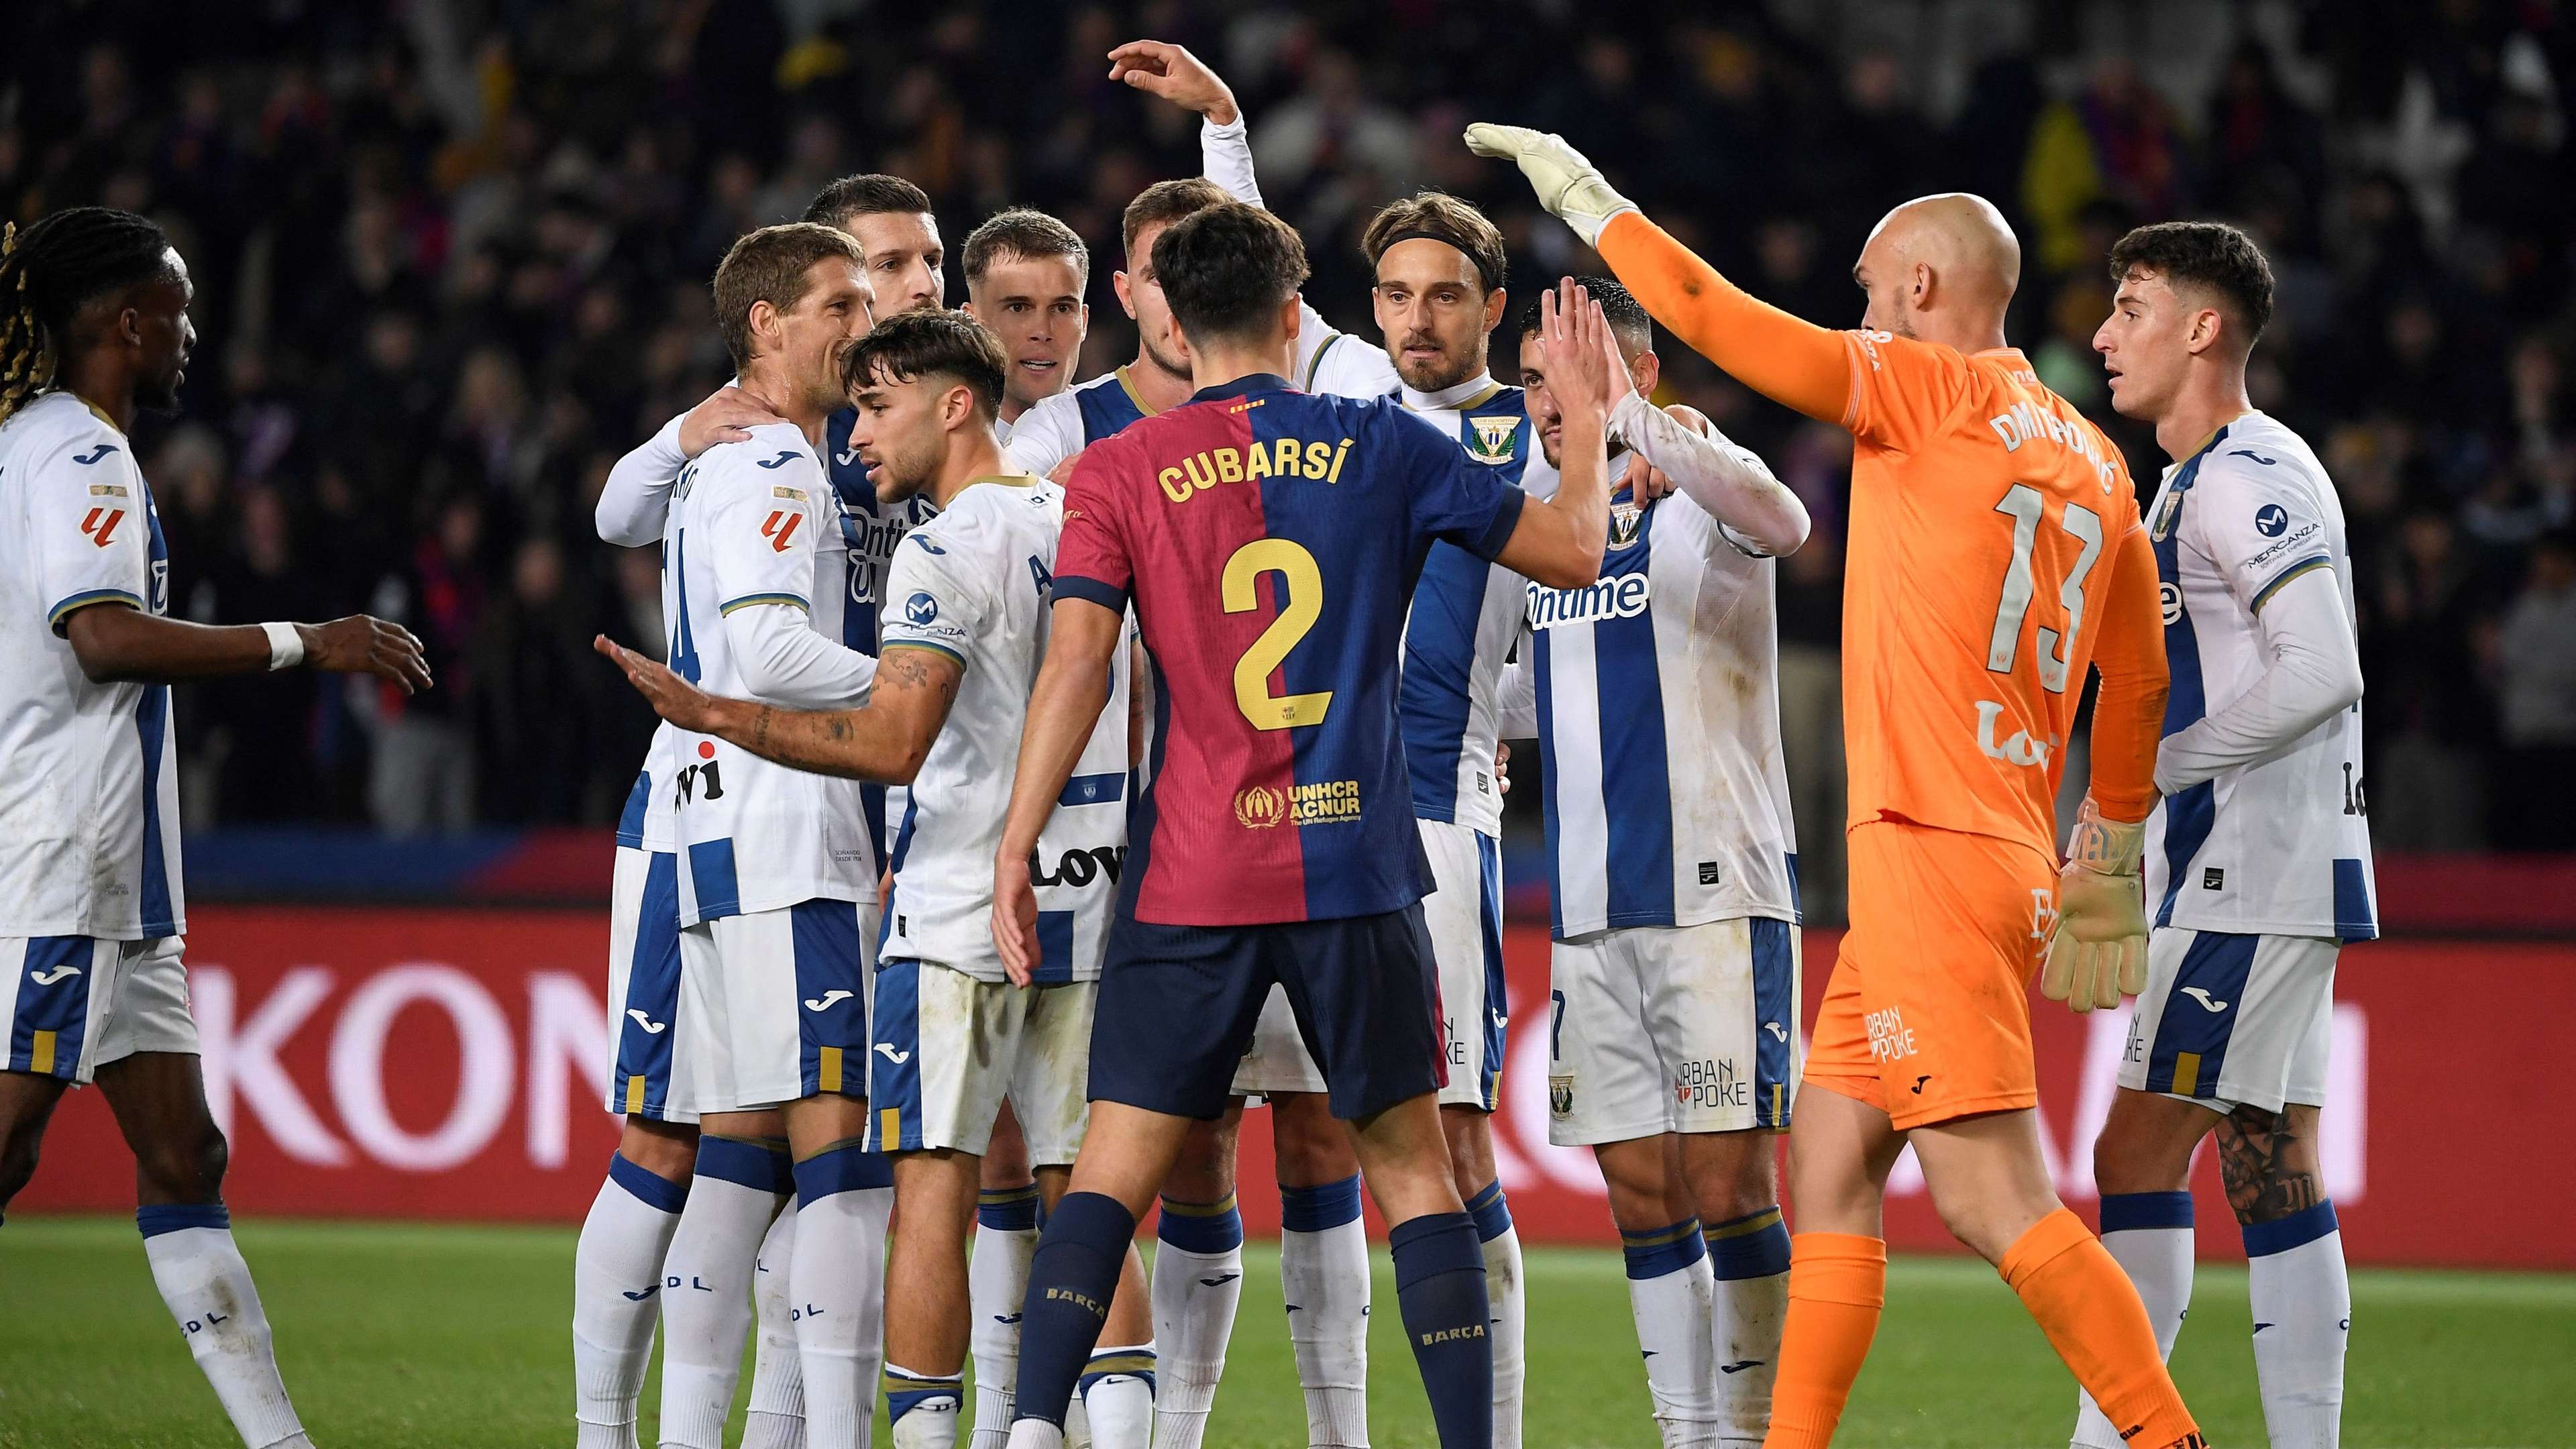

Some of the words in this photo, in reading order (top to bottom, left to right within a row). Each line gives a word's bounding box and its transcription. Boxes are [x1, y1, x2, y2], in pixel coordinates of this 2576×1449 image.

[1159, 437, 1354, 504] CUBARSÍ
[2248, 523, 2321, 569] MERCANZA
[1986, 482, 2104, 694] 13
[1221, 537, 1334, 731] 2
[1287, 781, 1359, 802] UNHCR
[1289, 798, 1360, 819] ACNUR
[1878, 1028, 1918, 1064] POKE
[1693, 1082, 1748, 1110] POKE
